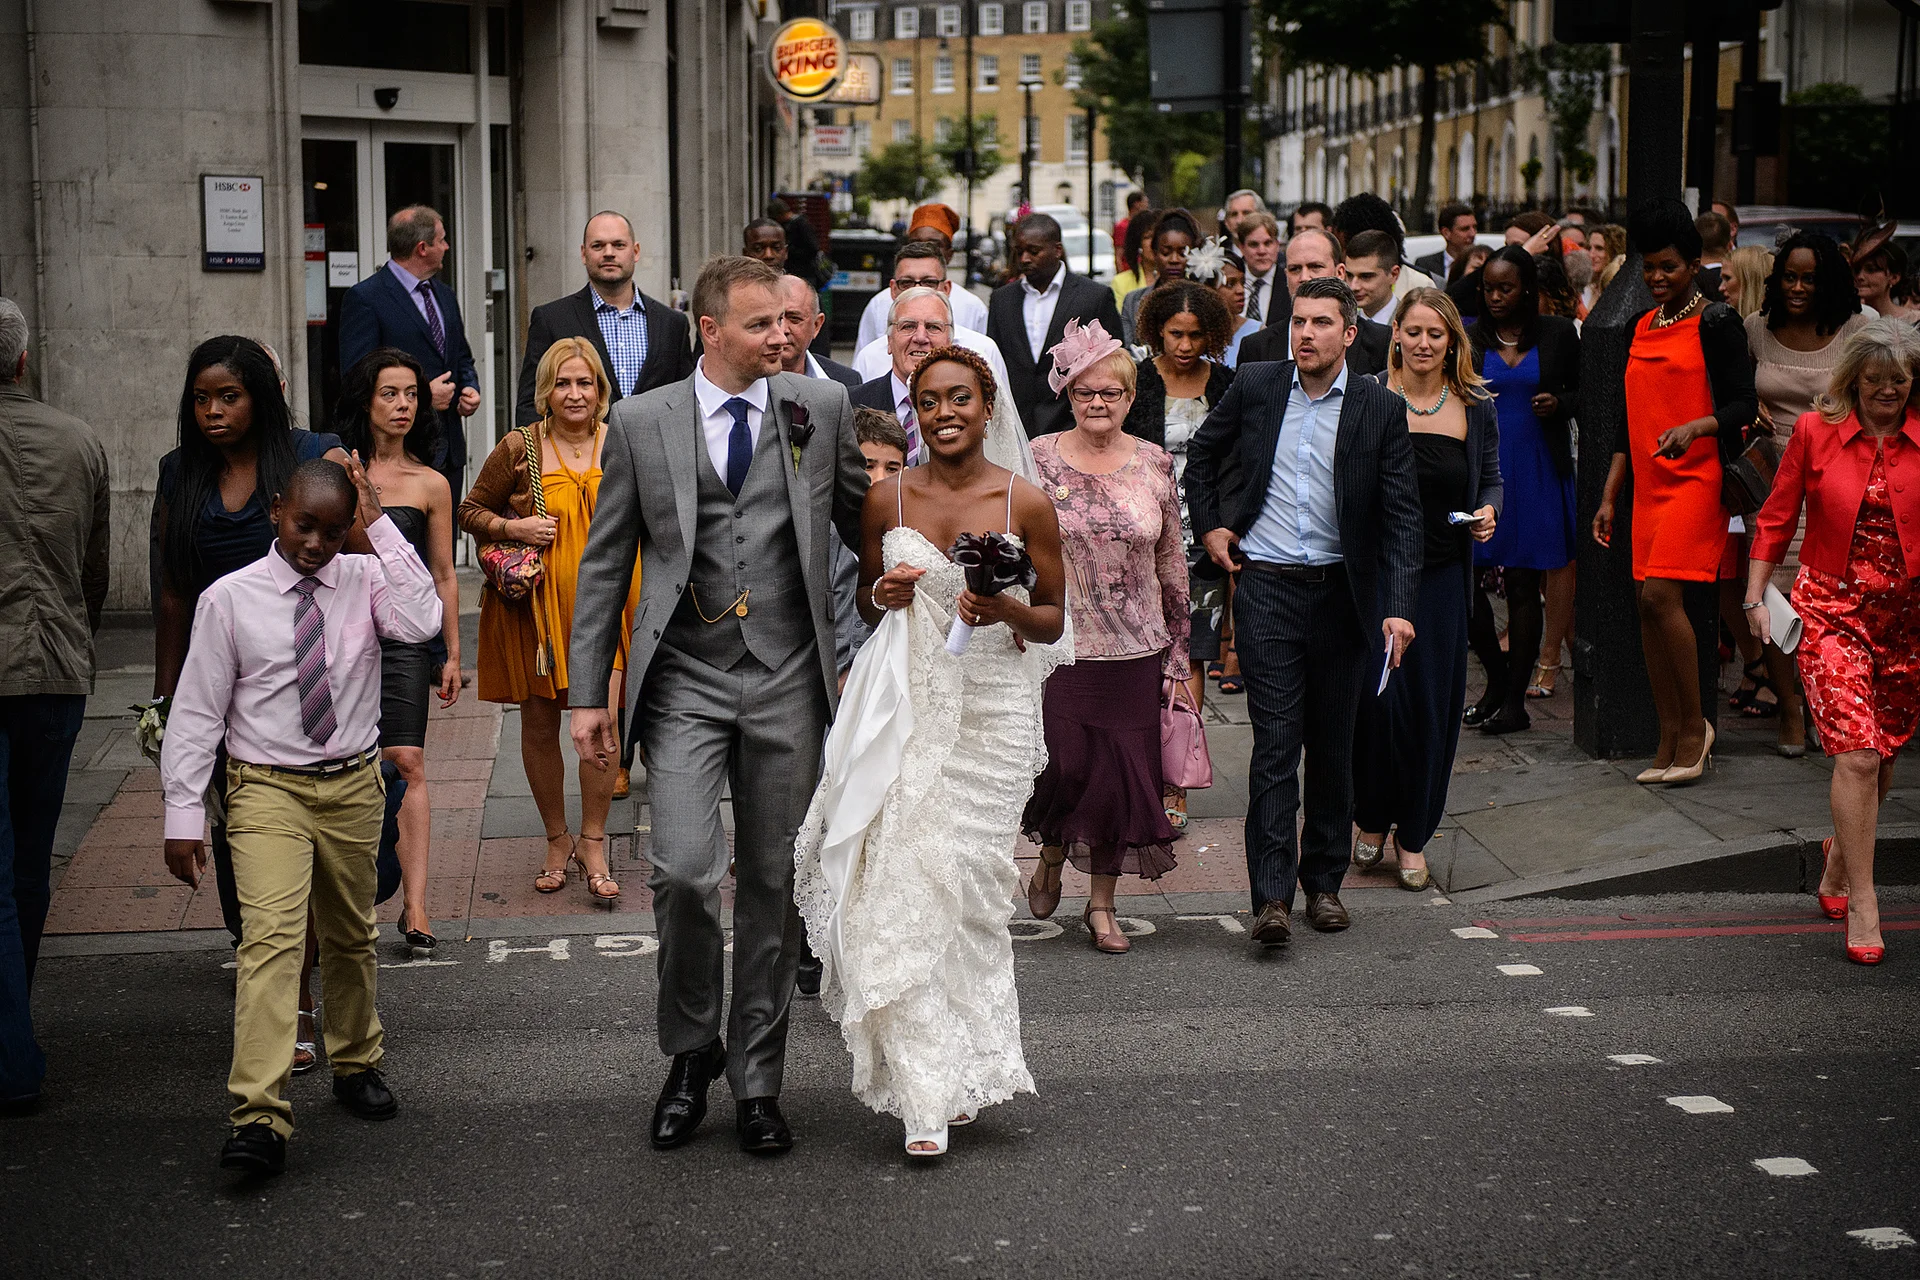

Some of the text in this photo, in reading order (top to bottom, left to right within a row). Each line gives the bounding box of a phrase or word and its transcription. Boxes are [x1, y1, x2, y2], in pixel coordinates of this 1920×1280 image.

[776, 38, 837, 59] BURGER
[777, 52, 837, 80] KING
[214, 182, 239, 192] HSBC
[209, 256, 261, 265] HSBC PREMIER
[1006, 914, 1247, 941] LOO
